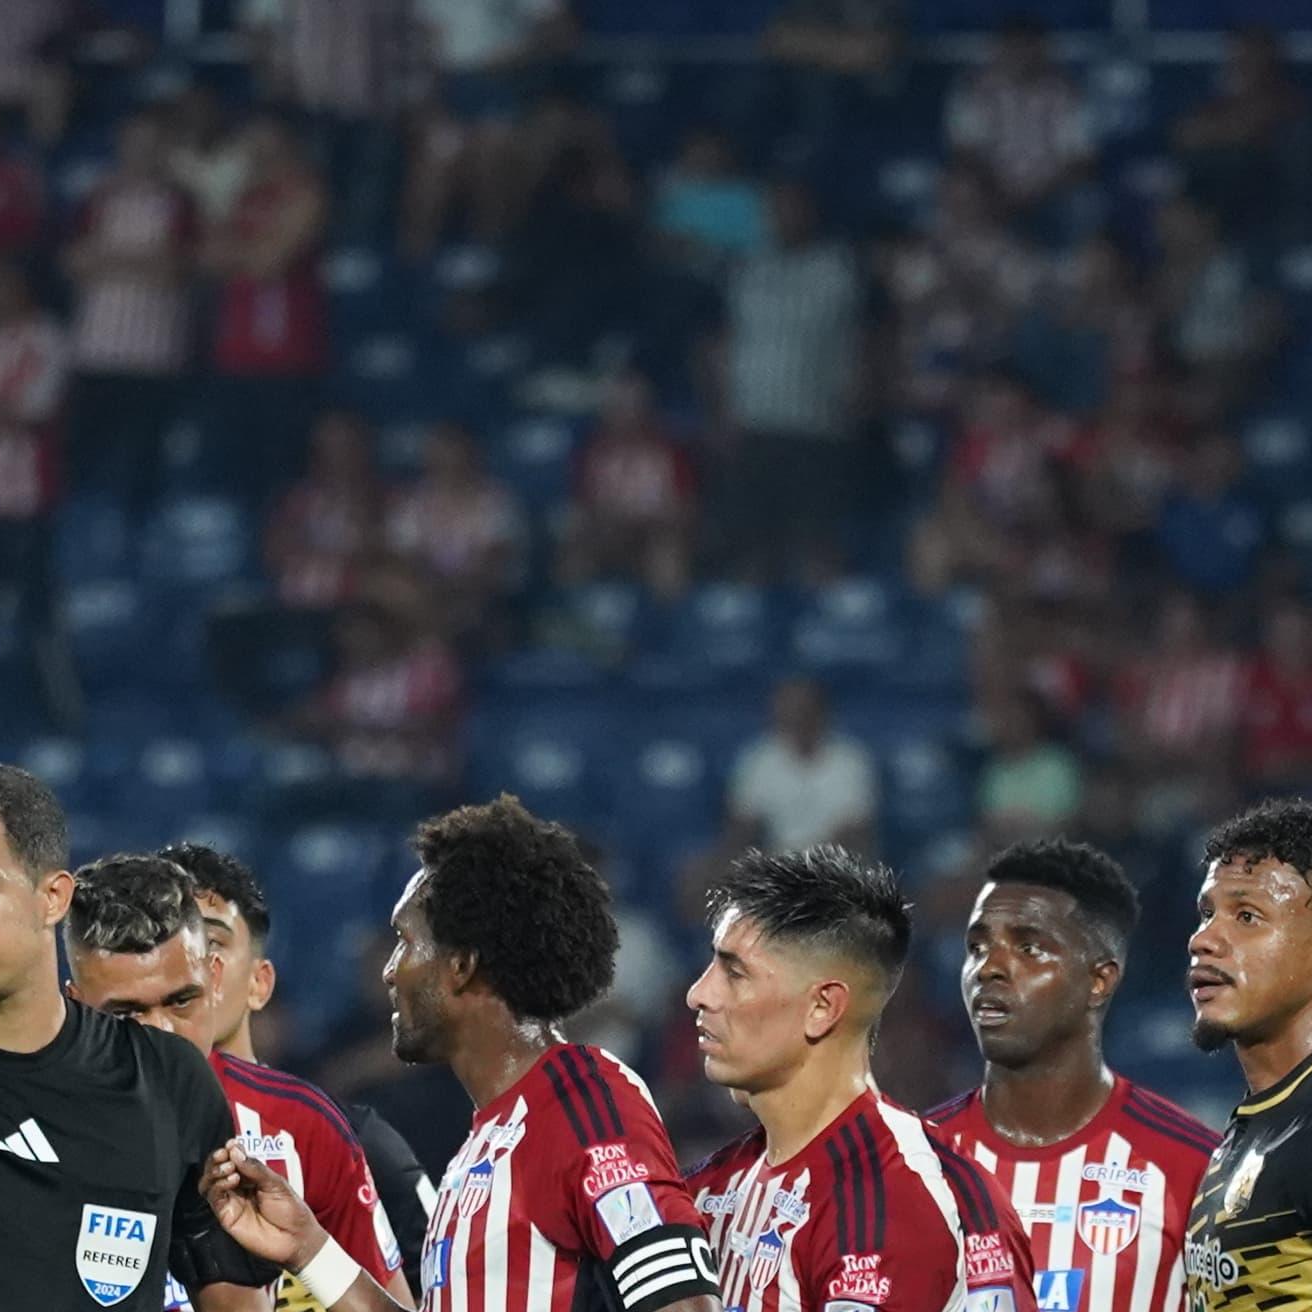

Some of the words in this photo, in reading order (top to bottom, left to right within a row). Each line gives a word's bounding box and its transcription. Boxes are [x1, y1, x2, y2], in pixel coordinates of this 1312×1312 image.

[586, 1144, 627, 1166] RON
[88, 1211, 146, 1243] FIFA
[967, 1232, 1001, 1251] RON
[82, 1249, 141, 1270] REFEREE
[93, 1282, 121, 1298] 2024
